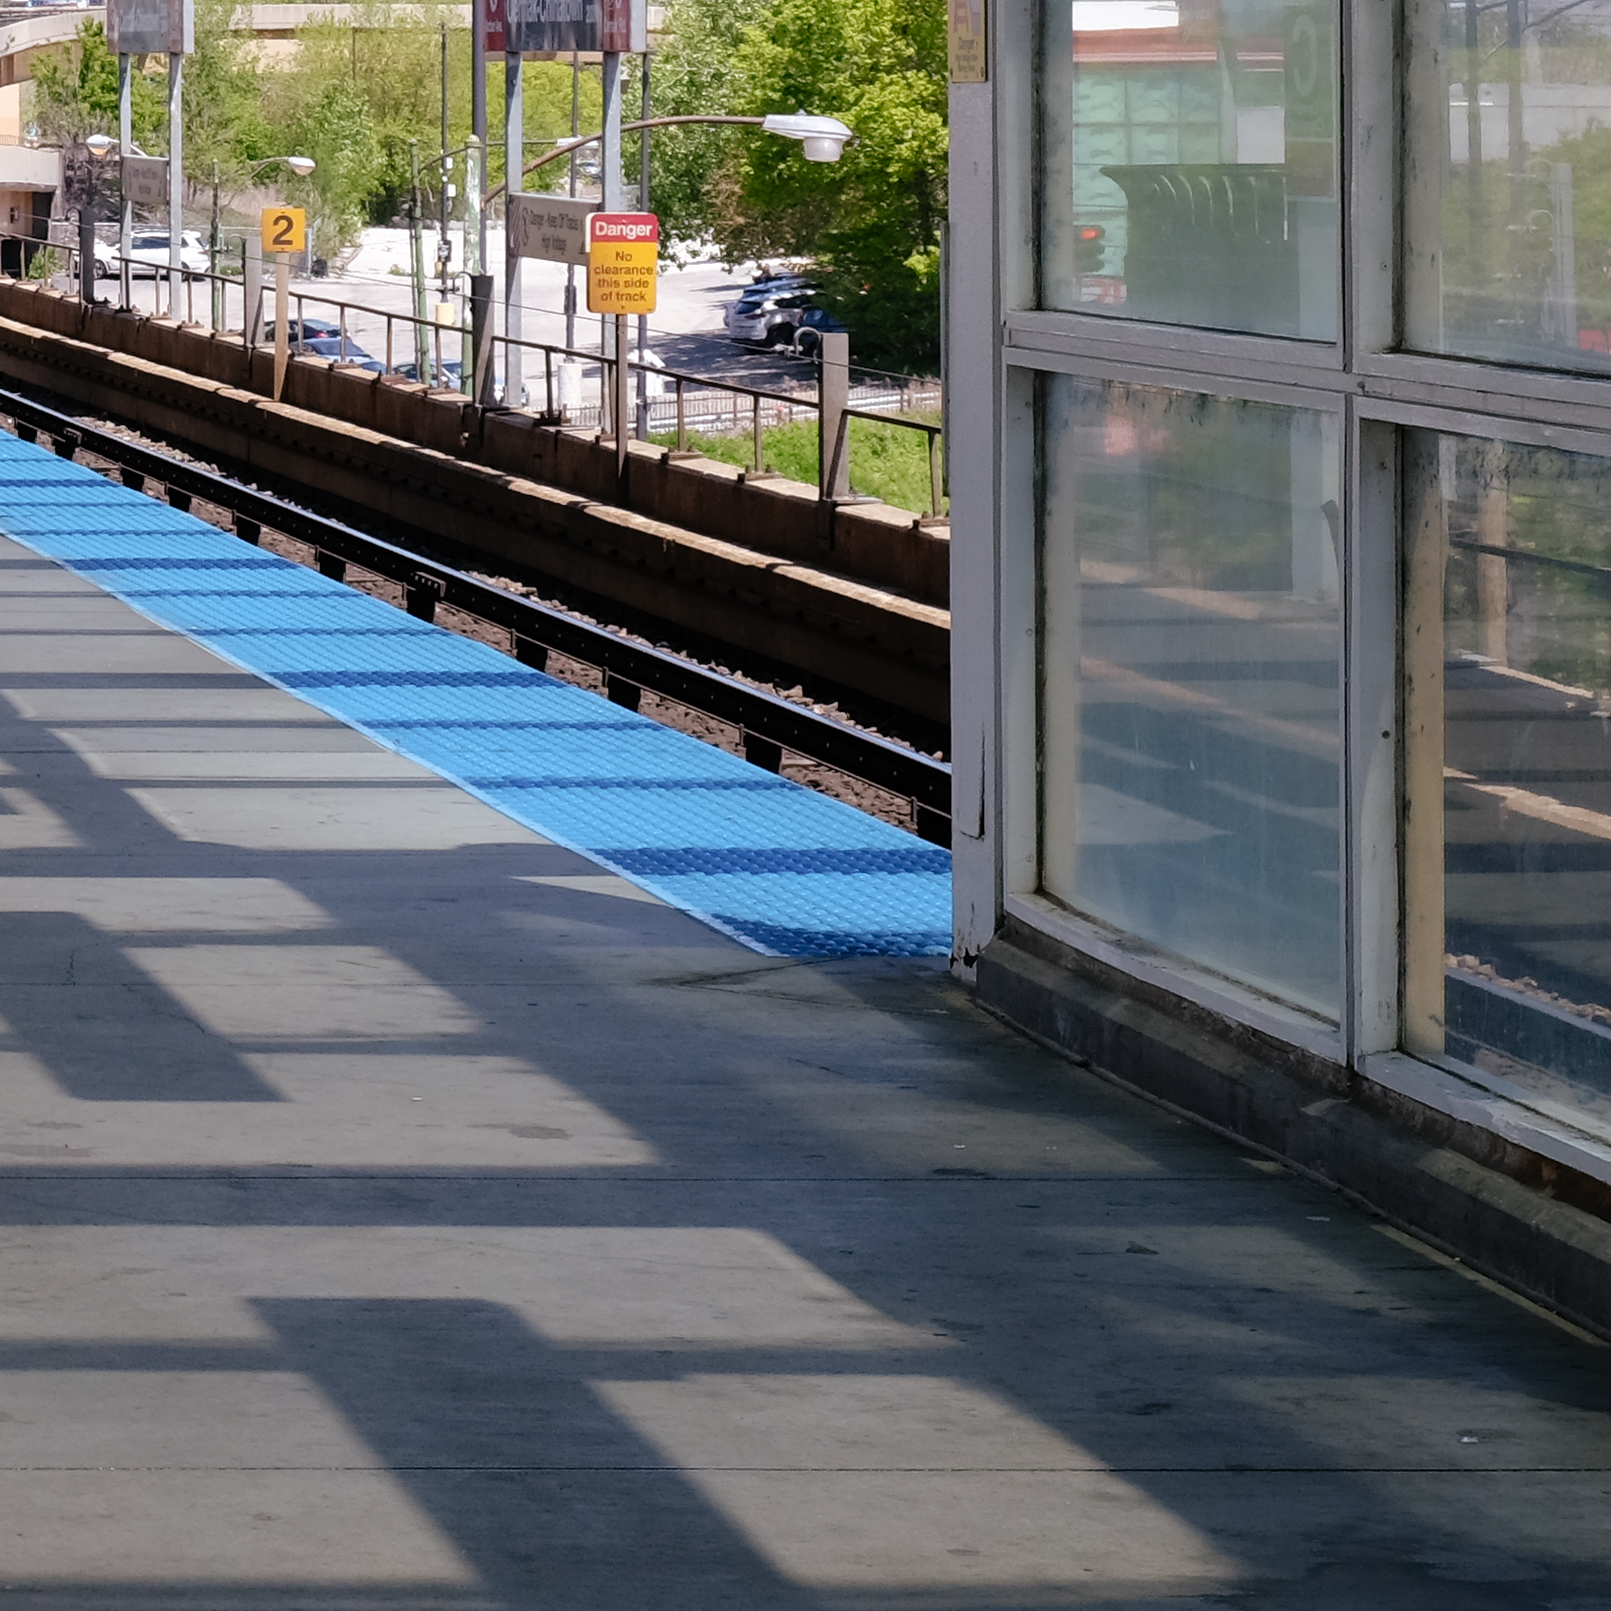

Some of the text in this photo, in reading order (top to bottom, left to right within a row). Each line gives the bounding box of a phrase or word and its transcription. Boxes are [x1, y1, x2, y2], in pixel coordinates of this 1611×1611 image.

[272, 215, 294, 246] 2
[595, 221, 653, 240] Danger
[615, 251, 633, 262] No
[594, 264, 654, 275] clearance
[597, 278, 650, 289] this side
[600, 291, 647, 302] of track
